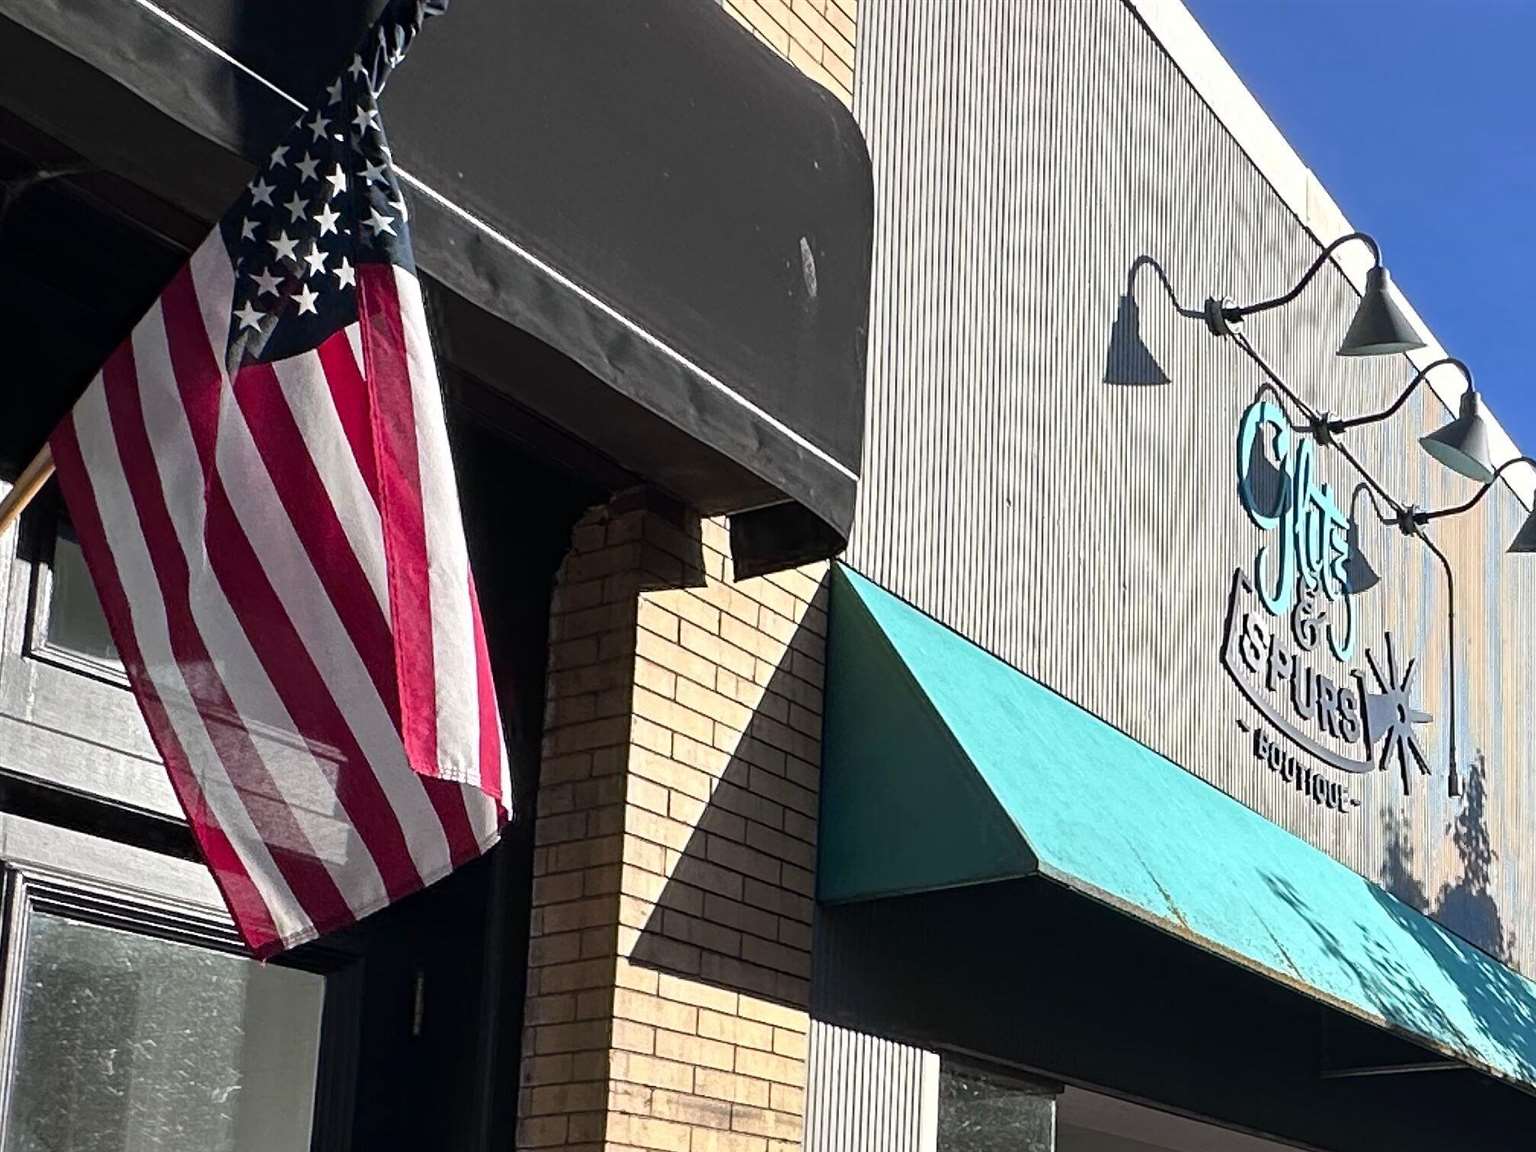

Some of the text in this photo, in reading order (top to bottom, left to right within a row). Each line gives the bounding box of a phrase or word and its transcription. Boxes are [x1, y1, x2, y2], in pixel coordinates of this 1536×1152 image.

[1291, 577, 1327, 652] &
[1240, 613, 1361, 744] SPURS
[1253, 727, 1351, 814] BOUTIQUE
